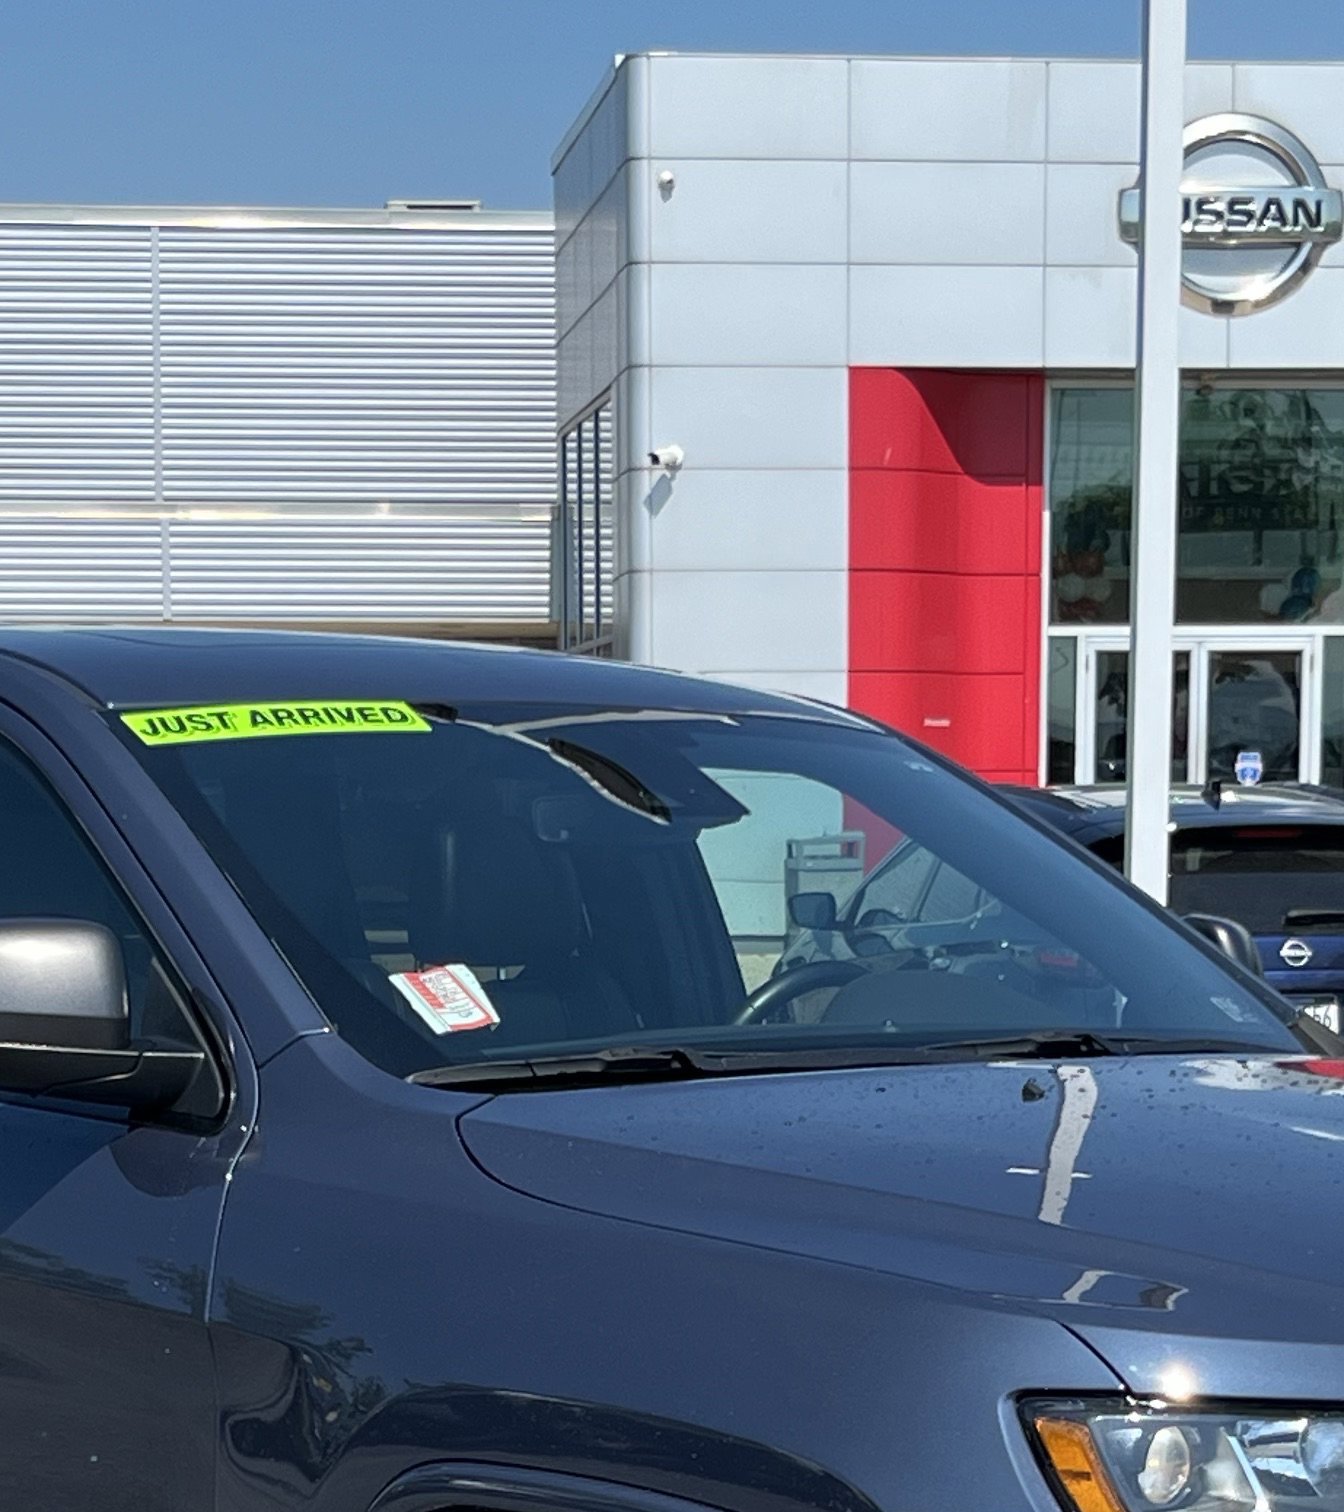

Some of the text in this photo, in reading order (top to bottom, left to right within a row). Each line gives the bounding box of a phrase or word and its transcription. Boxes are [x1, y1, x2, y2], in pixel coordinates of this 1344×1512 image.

[1181, 196, 1325, 232] ISSAN
[138, 705, 411, 737] JUST ARRIVED
